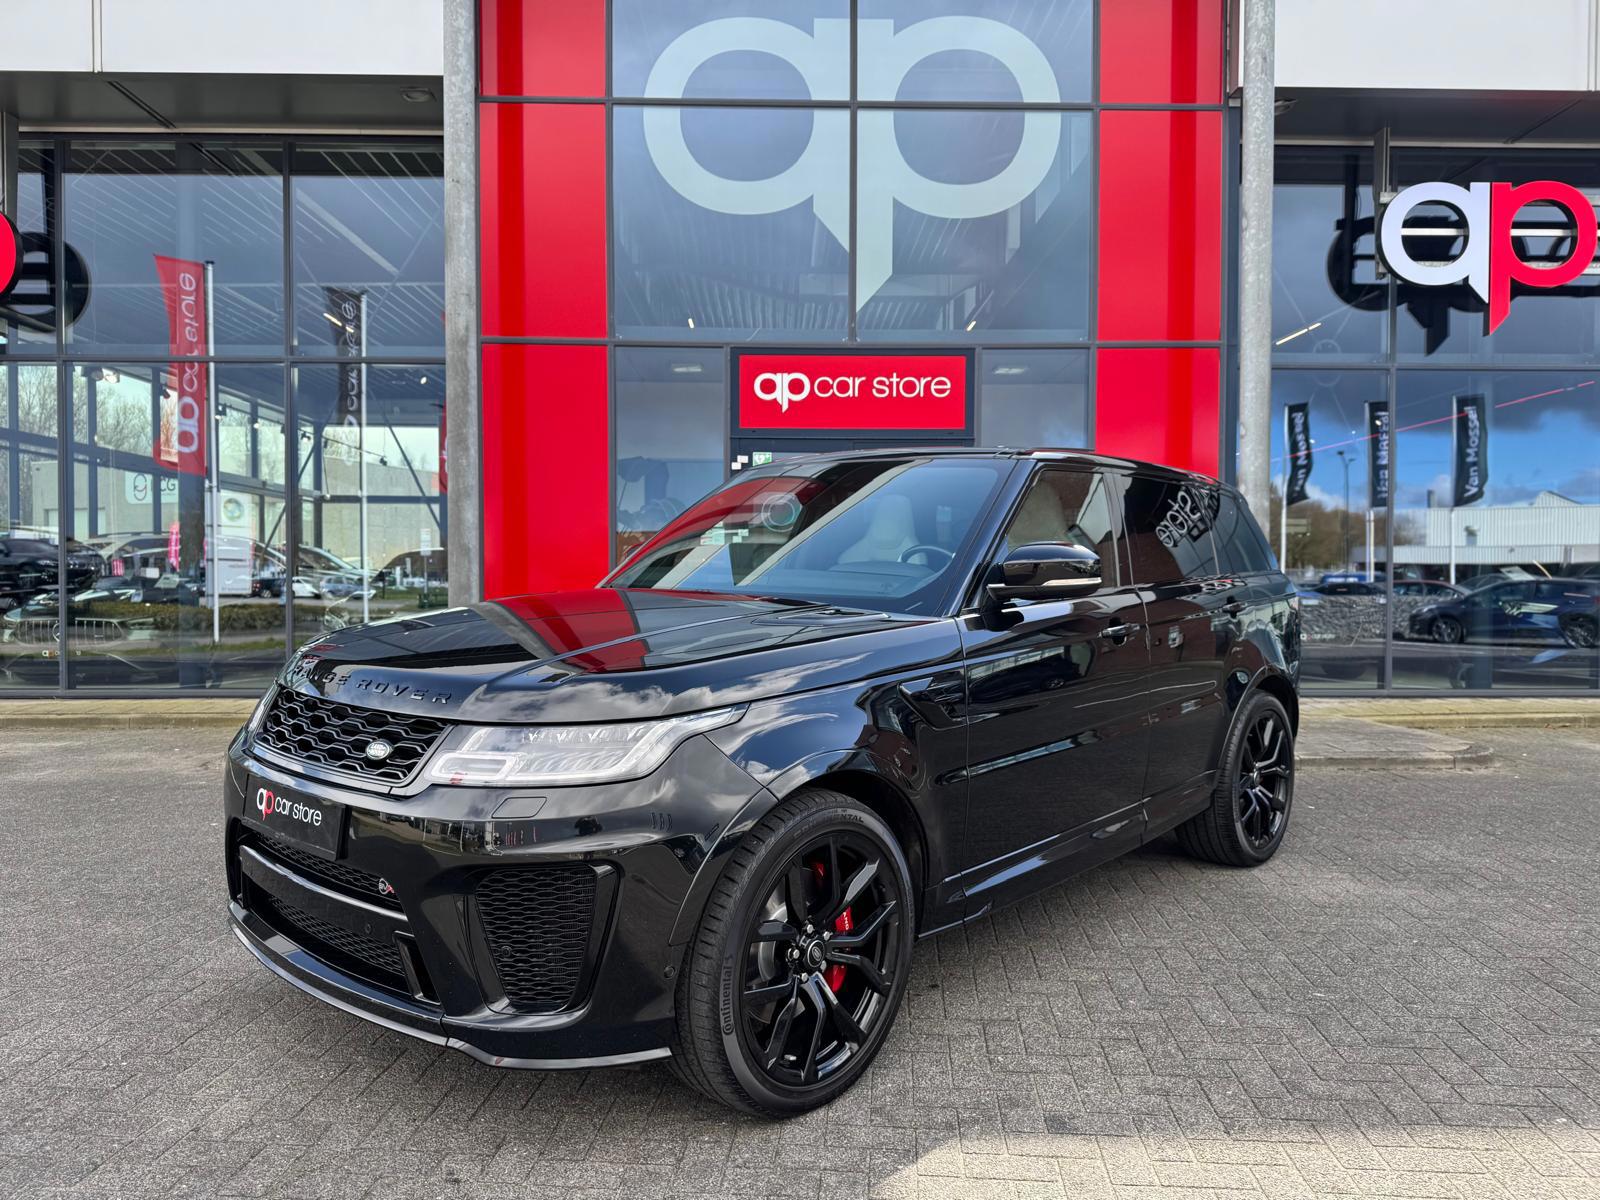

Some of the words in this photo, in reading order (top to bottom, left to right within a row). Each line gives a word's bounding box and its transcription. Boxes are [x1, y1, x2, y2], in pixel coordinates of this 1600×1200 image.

[753, 372, 811, 413] ap
[813, 375, 866, 398] car
[871, 371, 951, 399] store
[1464, 405, 1480, 462] Mossel
[1463, 467, 1479, 497] Van
[292, 666, 351, 686] RANGE
[355, 679, 452, 704] ROVER
[274, 796, 292, 815] car
[292, 802, 322, 826] store
[720, 965, 735, 1036] Continental
